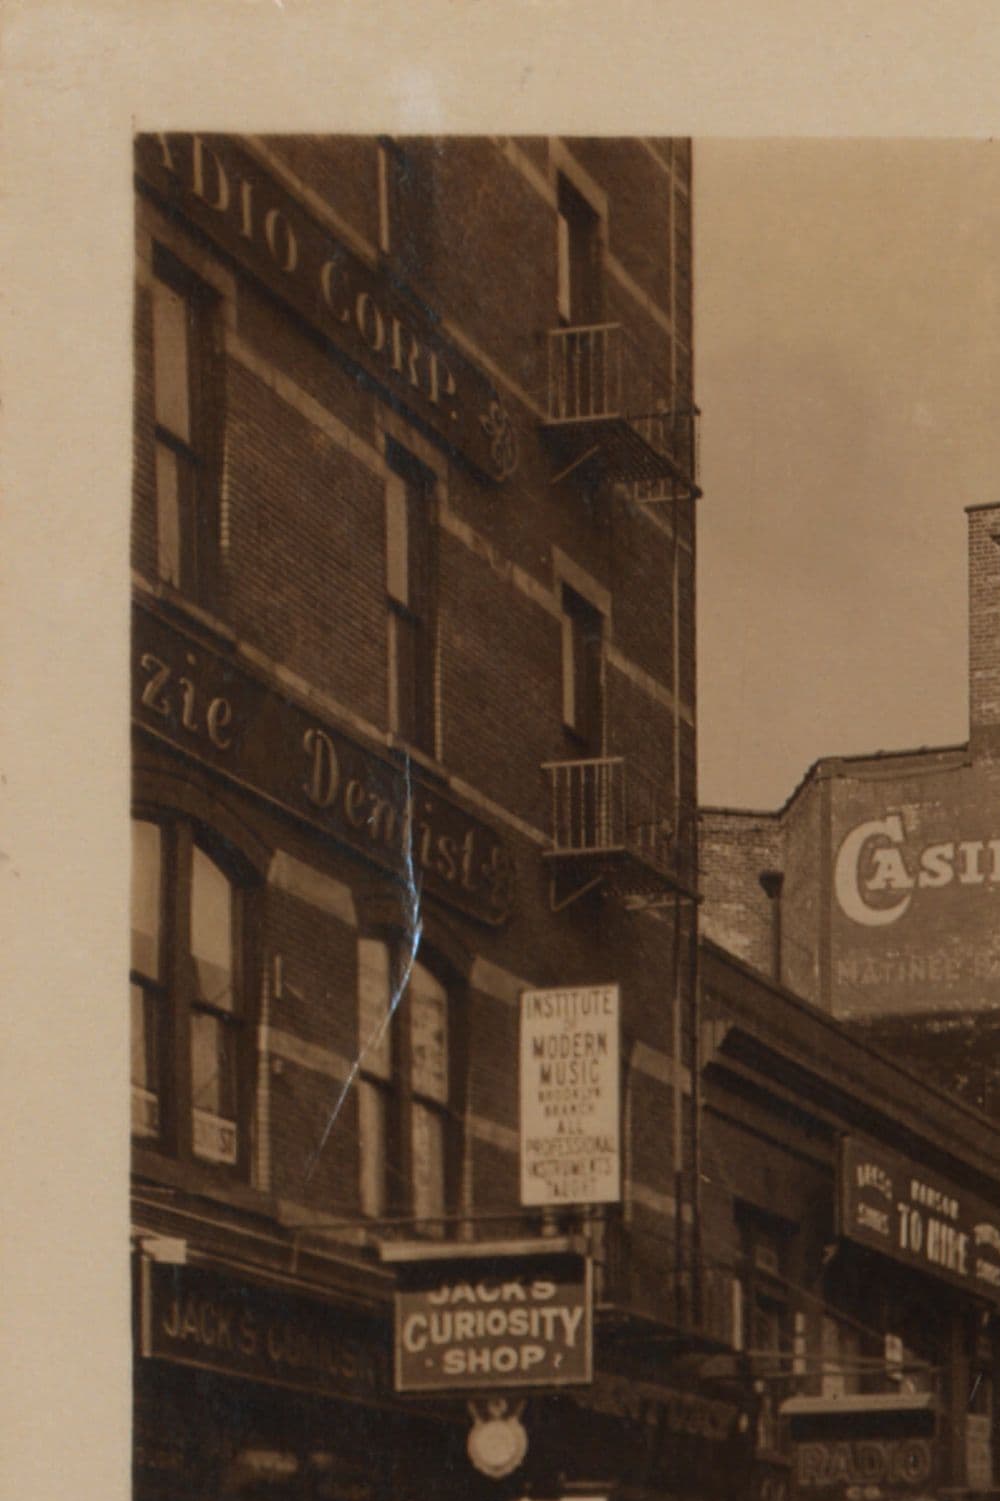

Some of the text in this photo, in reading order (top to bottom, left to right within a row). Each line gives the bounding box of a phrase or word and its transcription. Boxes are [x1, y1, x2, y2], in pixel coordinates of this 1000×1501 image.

[527, 989, 613, 1019] INSTITUTE
[532, 1032, 608, 1060] MODERN
[539, 1058, 600, 1086] MUSIC
[897, 1202, 923, 1253] TO
[403, 1306, 584, 1353] CURIOSITY
[443, 1344, 546, 1375] SHOP
[797, 1439, 932, 1486] RADIO
